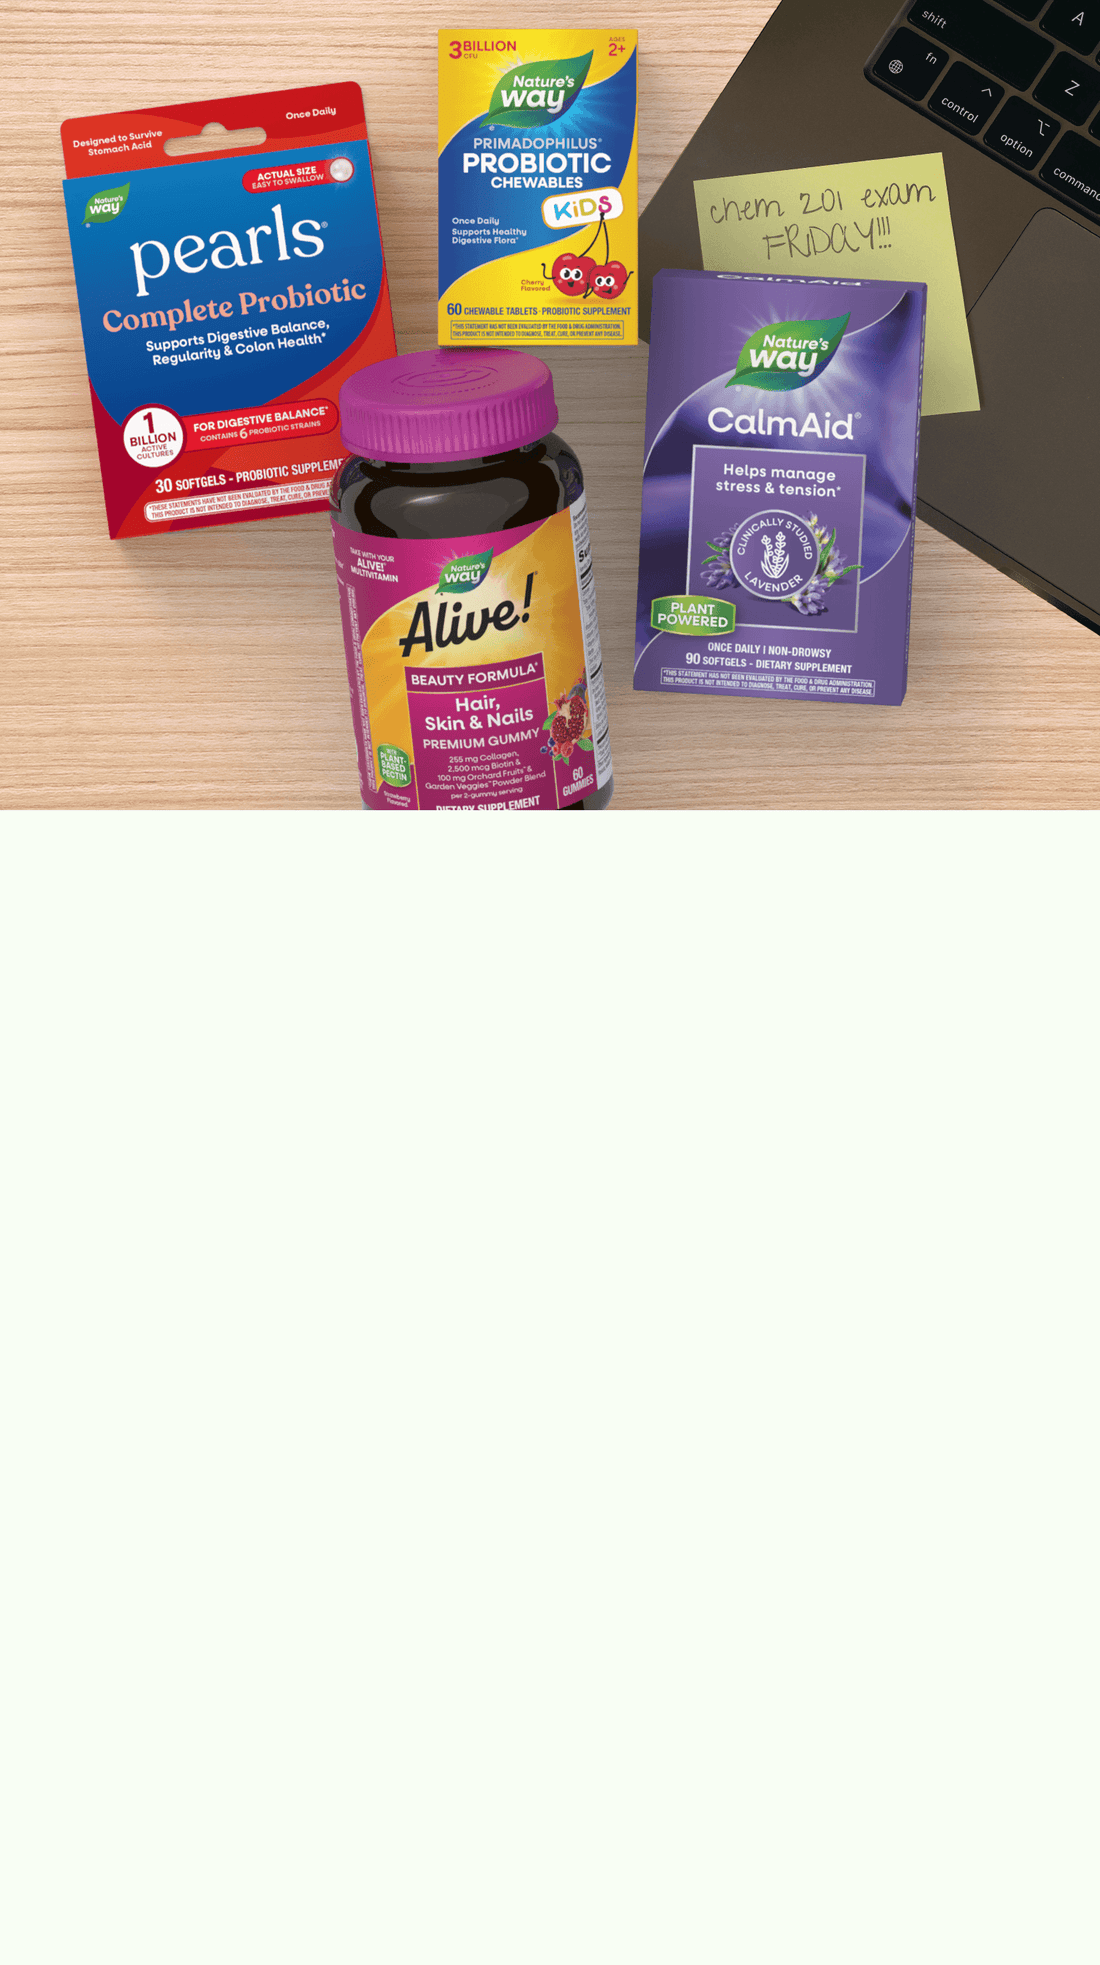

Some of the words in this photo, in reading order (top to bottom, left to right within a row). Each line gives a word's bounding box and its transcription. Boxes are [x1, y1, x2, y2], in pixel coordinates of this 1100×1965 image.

[922, 10, 948, 29] shift
[1071, 11, 1085, 26] A
[449, 40, 462, 60] 3
[464, 41, 516, 52] BILLION
[608, 43, 626, 56] 2+
[925, 52, 937, 64] fn
[513, 75, 574, 88] Nature's
[1064, 80, 1080, 96] Z
[501, 90, 565, 114] way
[941, 97, 979, 123] control
[286, 110, 311, 120] Once
[312, 106, 336, 118] Daily
[73, 136, 116, 148] Designed
[118, 134, 128, 142] to
[129, 129, 162, 140] Survive
[1000, 134, 1033, 158] option
[88, 144, 130, 156] Stomach
[132, 140, 152, 150] Acid
[462, 152, 612, 174] PROBIOTIC
[252, 180, 271, 190] EASY
[272, 178, 283, 186] TO
[284, 173, 324, 185] SWALLOW
[256, 167, 294, 181] ACTUAL
[296, 166, 317, 176] SIZE
[491, 176, 583, 189] CHEWABLES
[94, 194, 124, 205] Nature's
[710, 198, 784, 224] chem
[800, 188, 843, 214] 201
[860, 182, 936, 208] exam
[89, 201, 120, 215] way
[452, 217, 476, 225] Once
[478, 217, 500, 226] Daily
[452, 228, 490, 236] Supports
[492, 228, 527, 236] Healthy
[452, 236, 492, 245] Digestive
[103, 299, 234, 333] Complete
[238, 278, 366, 316] Probiotic
[447, 303, 462, 316] 60
[464, 307, 504, 316] CHEWABLE
[542, 307, 580, 316] PROBIOTIC
[582, 307, 631, 316] SUPPLEMENT
[146, 334, 204, 352] Supports
[207, 326, 268, 345] Digestive
[270, 320, 330, 337] Balance,
[762, 334, 829, 350] Nature's
[152, 347, 221, 366] Regularity
[223, 345, 234, 356] &
[235, 341, 276, 355] Colon
[750, 348, 819, 377] way
[142, 412, 155, 434] 1
[194, 421, 216, 433] FOR
[217, 412, 273, 430] DIGESTIVE
[200, 431, 238, 442] CONTAINS
[239, 428, 248, 440] 6
[249, 425, 289, 436] PROBIOTIC
[290, 420, 321, 431] STRAINS
[130, 432, 177, 448] BILLION
[136, 450, 174, 460] CULTURES
[141, 443, 168, 454] ACTIVE
[155, 478, 174, 494] 30
[176, 474, 227, 491] SOFTGELS
[236, 466, 290, 483] PROBIOTIC
[724, 464, 766, 478] Helps
[771, 467, 836, 484] manage
[716, 480, 760, 493] stress
[764, 482, 775, 494] &
[168, 500, 202, 510] STATEMENTS
[202, 497, 216, 505] HAVE
[242, 490, 272, 499] EVALUATED
[737, 518, 784, 556] CLINICALLY
[785, 520, 813, 560] STUDIED
[362, 551, 376, 560] WITH
[377, 554, 394, 562] YOUR
[357, 558, 384, 572] ALIVE!
[450, 562, 486, 573] Nature's
[350, 565, 398, 582] MULTIVITAMIN
[444, 570, 481, 584] way
[744, 571, 804, 593] LAVENDER
[398, 572, 535, 658] Alive!
[670, 602, 716, 616] PLANT
[657, 614, 728, 628] POWERED
[708, 642, 733, 653] ONCE
[734, 643, 761, 654] DAILY
[768, 646, 832, 659] NON-DROWSY
[686, 652, 701, 665] 90
[702, 656, 747, 668] SOFTGELS
[756, 659, 793, 670] DIETARY
[794, 661, 852, 674] SUPPLEMENT
[411, 674, 464, 686] BEAUTY
[455, 694, 500, 713] Hair,
[425, 716, 466, 732] Skin
[470, 716, 483, 730] &
[488, 706, 534, 728] Nails
[422, 736, 485, 751] PREMIUM
[490, 728, 540, 748] GUMMY
[380, 751, 407, 764] PLANT-
[480, 751, 520, 762] Collagen,
[381, 760, 406, 772] BASED
[452, 774, 466, 782] mg
[467, 770, 502, 781] Orchard
[526, 764, 533, 772] &
[471, 764, 490, 772] mcg
[491, 760, 514, 770] Biotin
[572, 766, 584, 781] 60
[382, 768, 408, 782] PECTIN
[425, 782, 456, 790] Garden
[492, 776, 523, 787] Powder
[524, 770, 546, 782] Blend
[464, 791, 498, 799] 2-gummy
[498, 786, 524, 796] serving
[562, 773, 594, 797] GUMMIES
